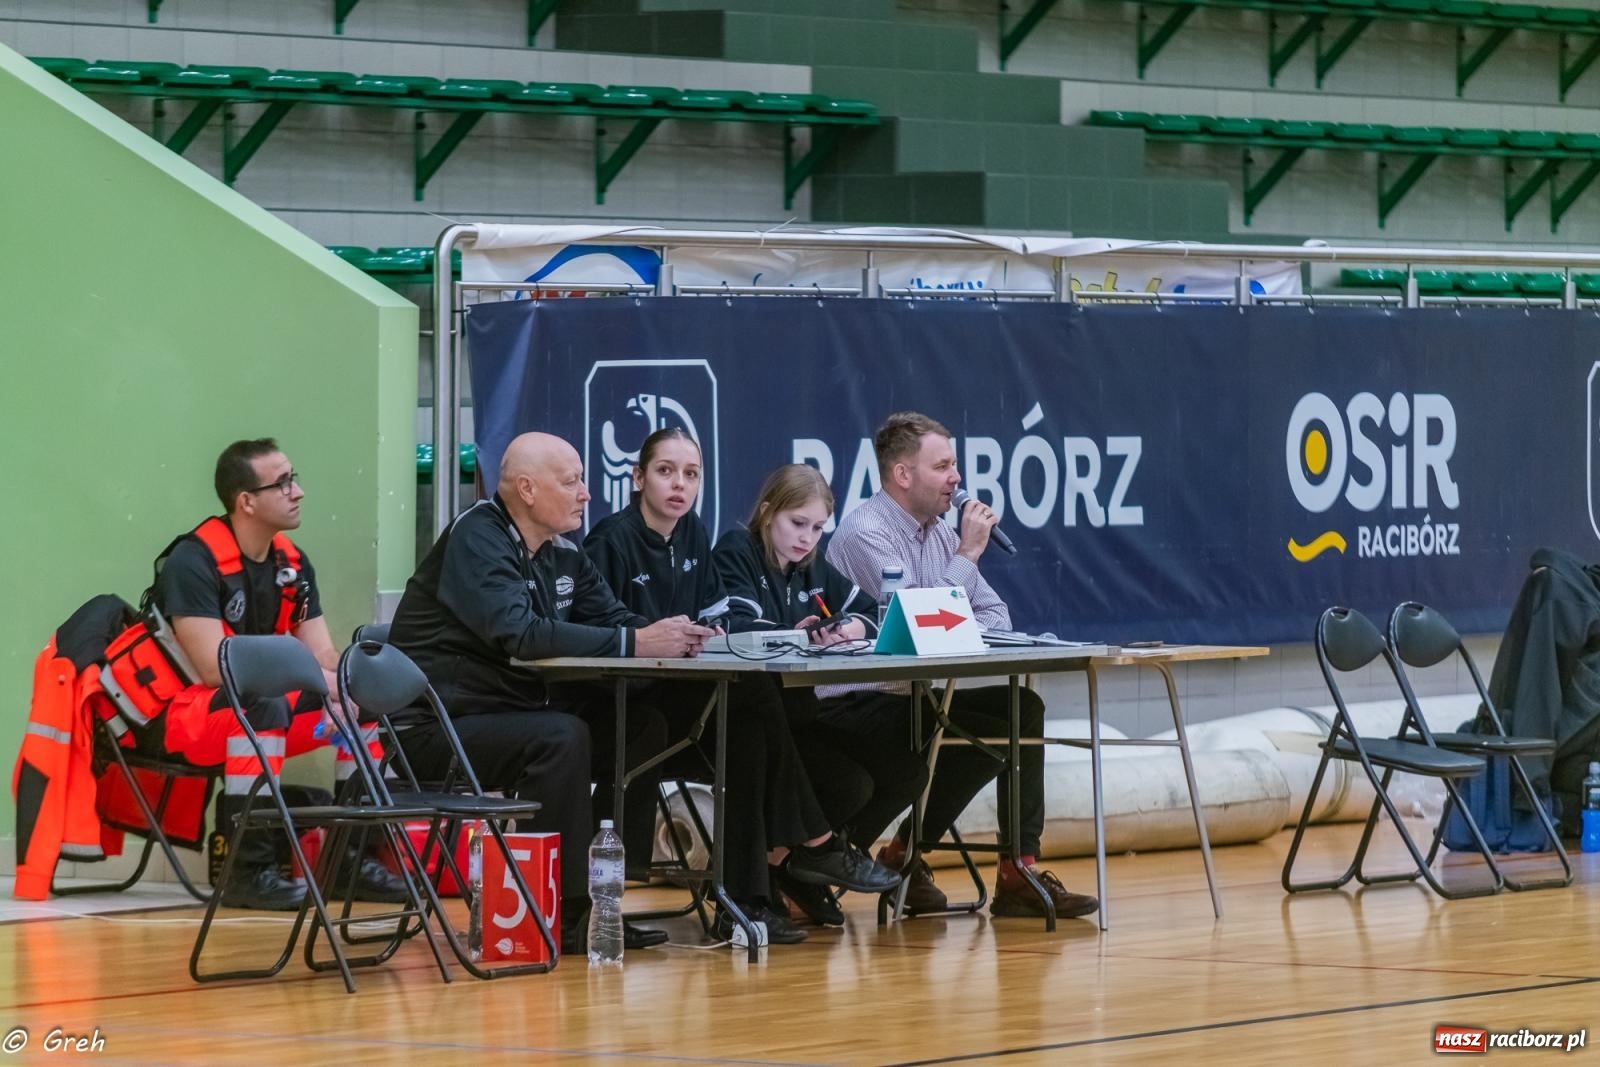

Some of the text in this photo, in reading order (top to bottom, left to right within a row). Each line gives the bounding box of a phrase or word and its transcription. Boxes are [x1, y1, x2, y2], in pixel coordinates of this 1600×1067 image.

[792, 401, 1144, 530] RABÓRZ
[1357, 514, 1460, 558] RACIBÓRZ
[492, 849, 532, 929] 5
